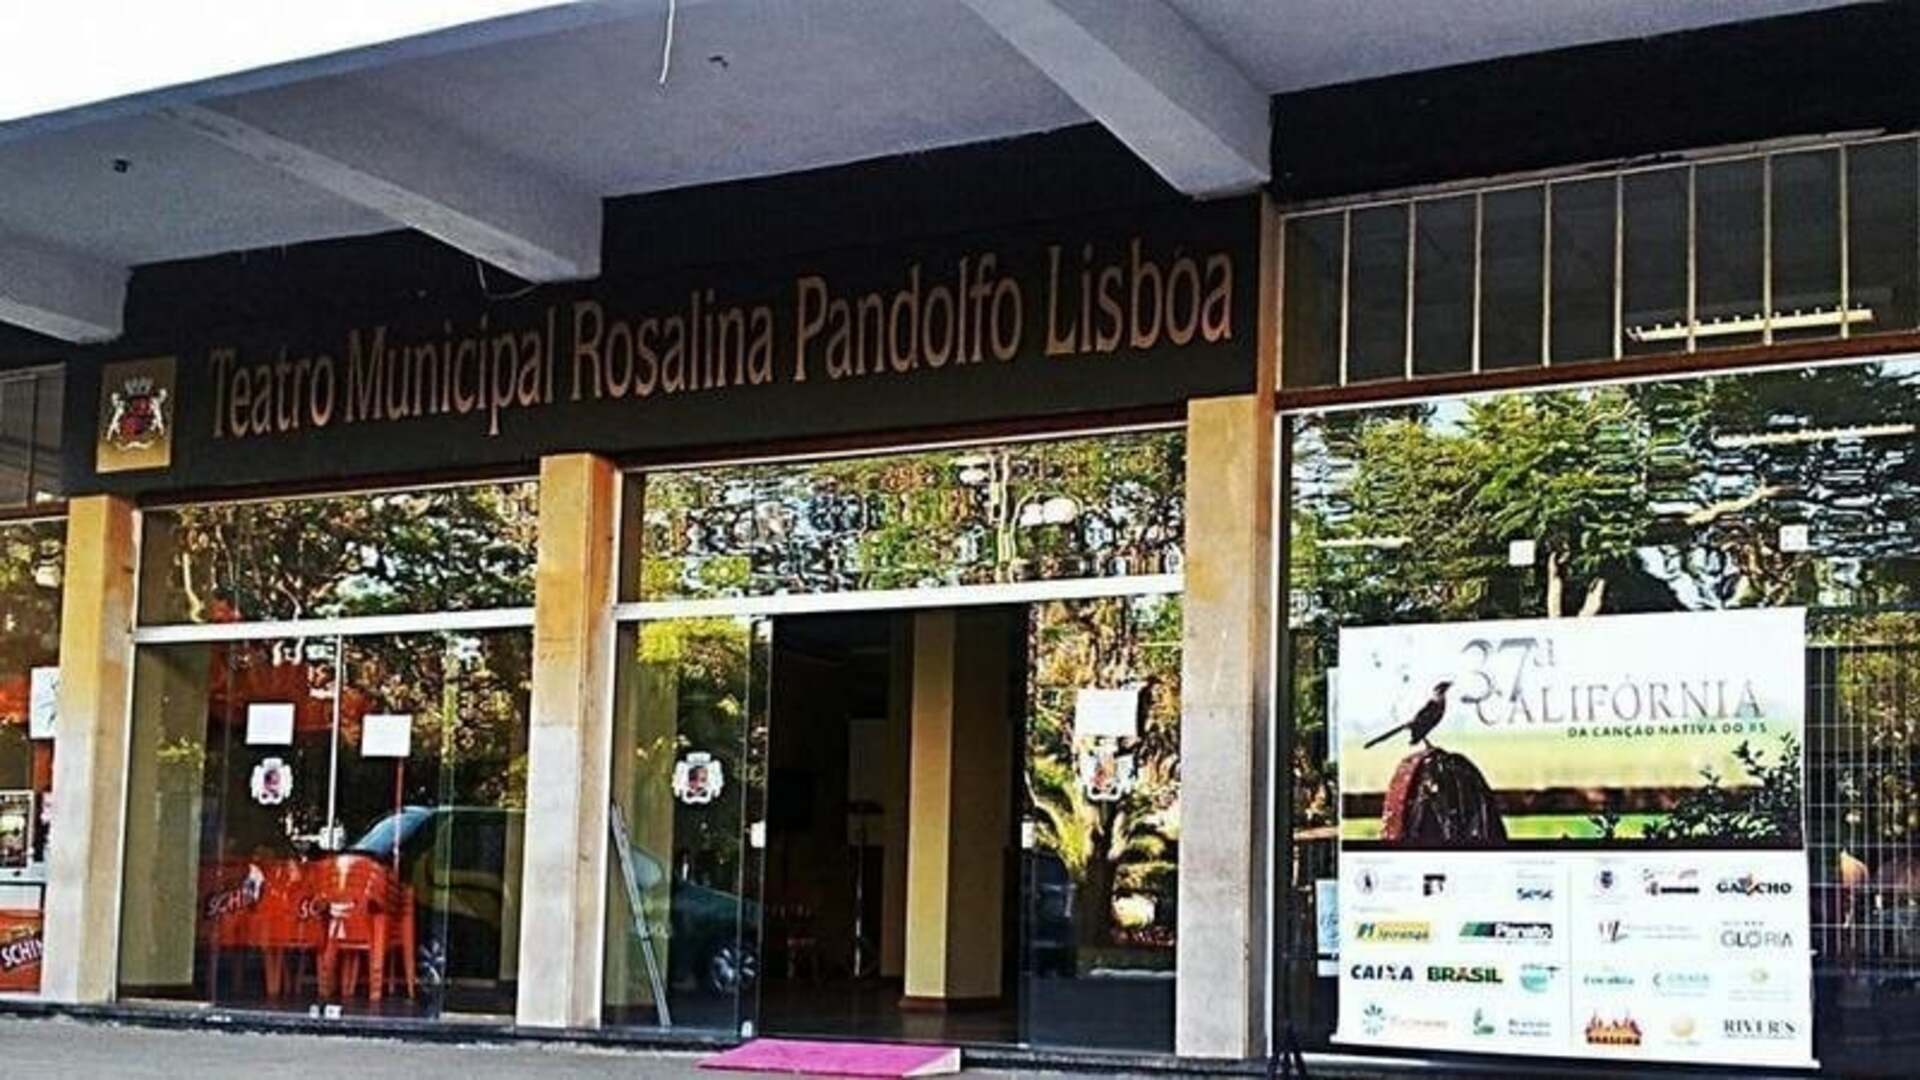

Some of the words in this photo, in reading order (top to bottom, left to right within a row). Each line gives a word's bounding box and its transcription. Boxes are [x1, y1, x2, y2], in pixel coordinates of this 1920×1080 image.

[208, 345, 336, 438] Teatro
[345, 301, 555, 436] Municipal
[571, 288, 774, 401] Rosalina
[793, 252, 1023, 382] Pandolfo
[1477, 672, 1767, 726] CALIFÓRNIA
[1567, 726, 1588, 738] DA
[1658, 722, 1717, 736] NATIVA
[1722, 722, 1744, 735] DO
[1350, 963, 1414, 981] CAIXA
[1426, 965, 1504, 984] BRASIL
